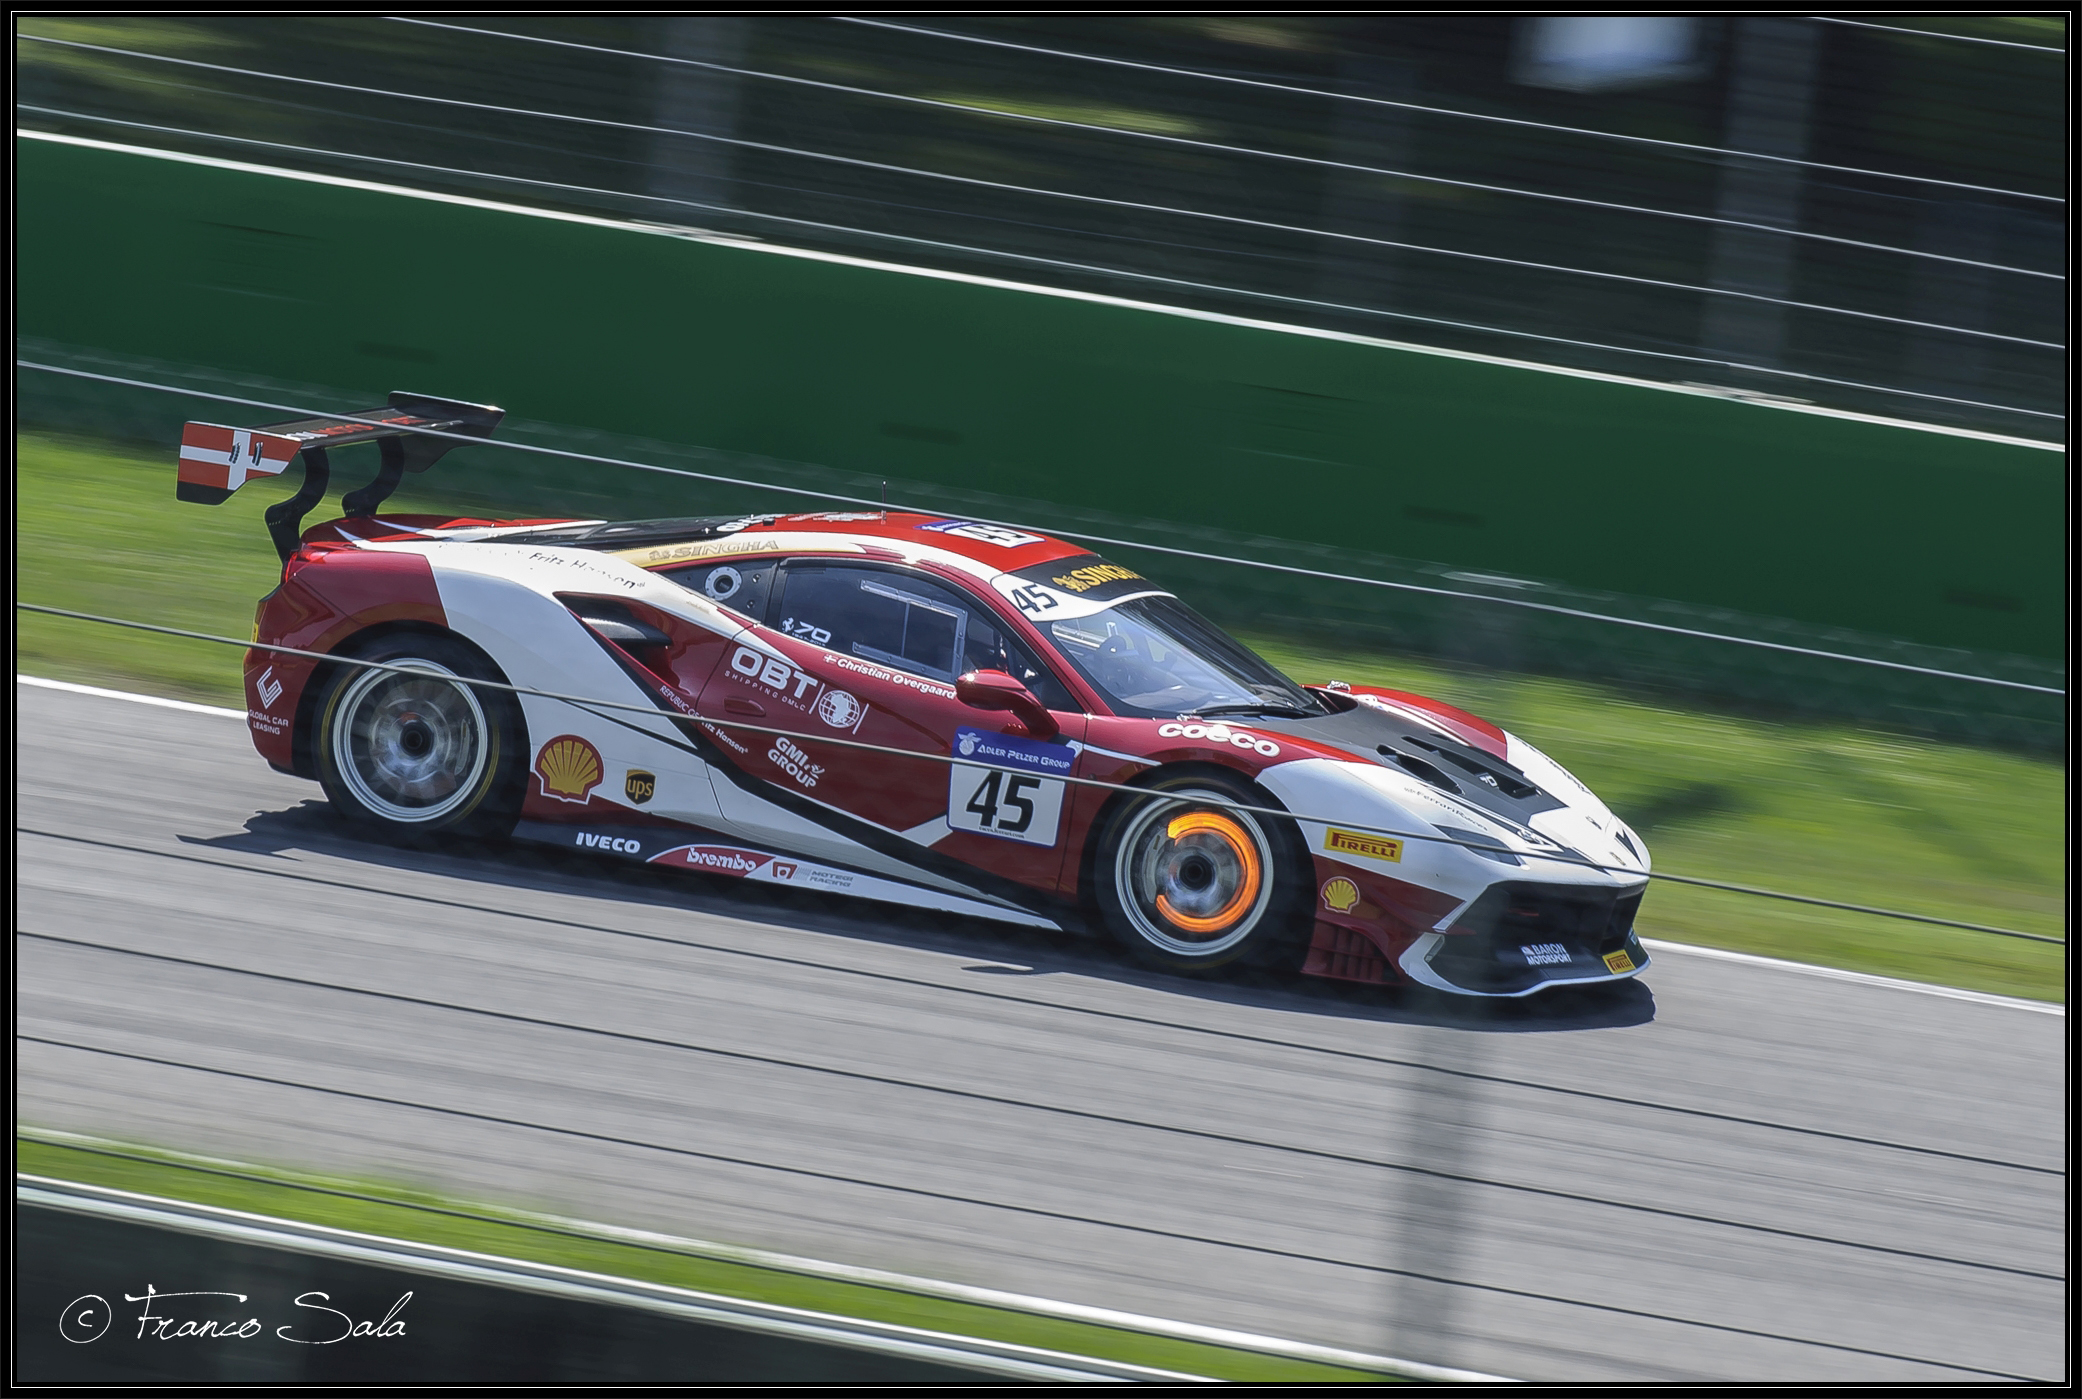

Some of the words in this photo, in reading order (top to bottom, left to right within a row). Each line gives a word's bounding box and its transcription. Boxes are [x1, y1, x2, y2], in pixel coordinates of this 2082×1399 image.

[673, 540, 779, 557] SINGHA
[1011, 582, 1059, 613] 45
[794, 620, 832, 644] 70
[724, 670, 779, 699] SHIPPING
[731, 646, 818, 699] OBT
[837, 657, 891, 681] Christian
[892, 673, 957, 700] Overgaard
[659, 685, 690, 713] REPUBLIC
[248, 709, 271, 723] GLOBAL
[272, 716, 289, 727] CAR
[252, 721, 281, 735] LEASING
[775, 736, 808, 766] GMI
[977, 744, 1006, 757] ADLER
[1007, 749, 1040, 764] PELZER
[1040, 756, 1071, 769] GROUP
[767, 749, 817, 788] GROUP
[627, 778, 653, 800] ups
[965, 770, 1042, 833] 45
[576, 832, 641, 854] IVECO
[1330, 831, 1398, 857] PIRELLI
[686, 846, 757, 872] brembo
[809, 876, 852, 888] RACING
[1525, 952, 1572, 966] MOTORSPORT
[1530, 942, 1567, 955] BARON
